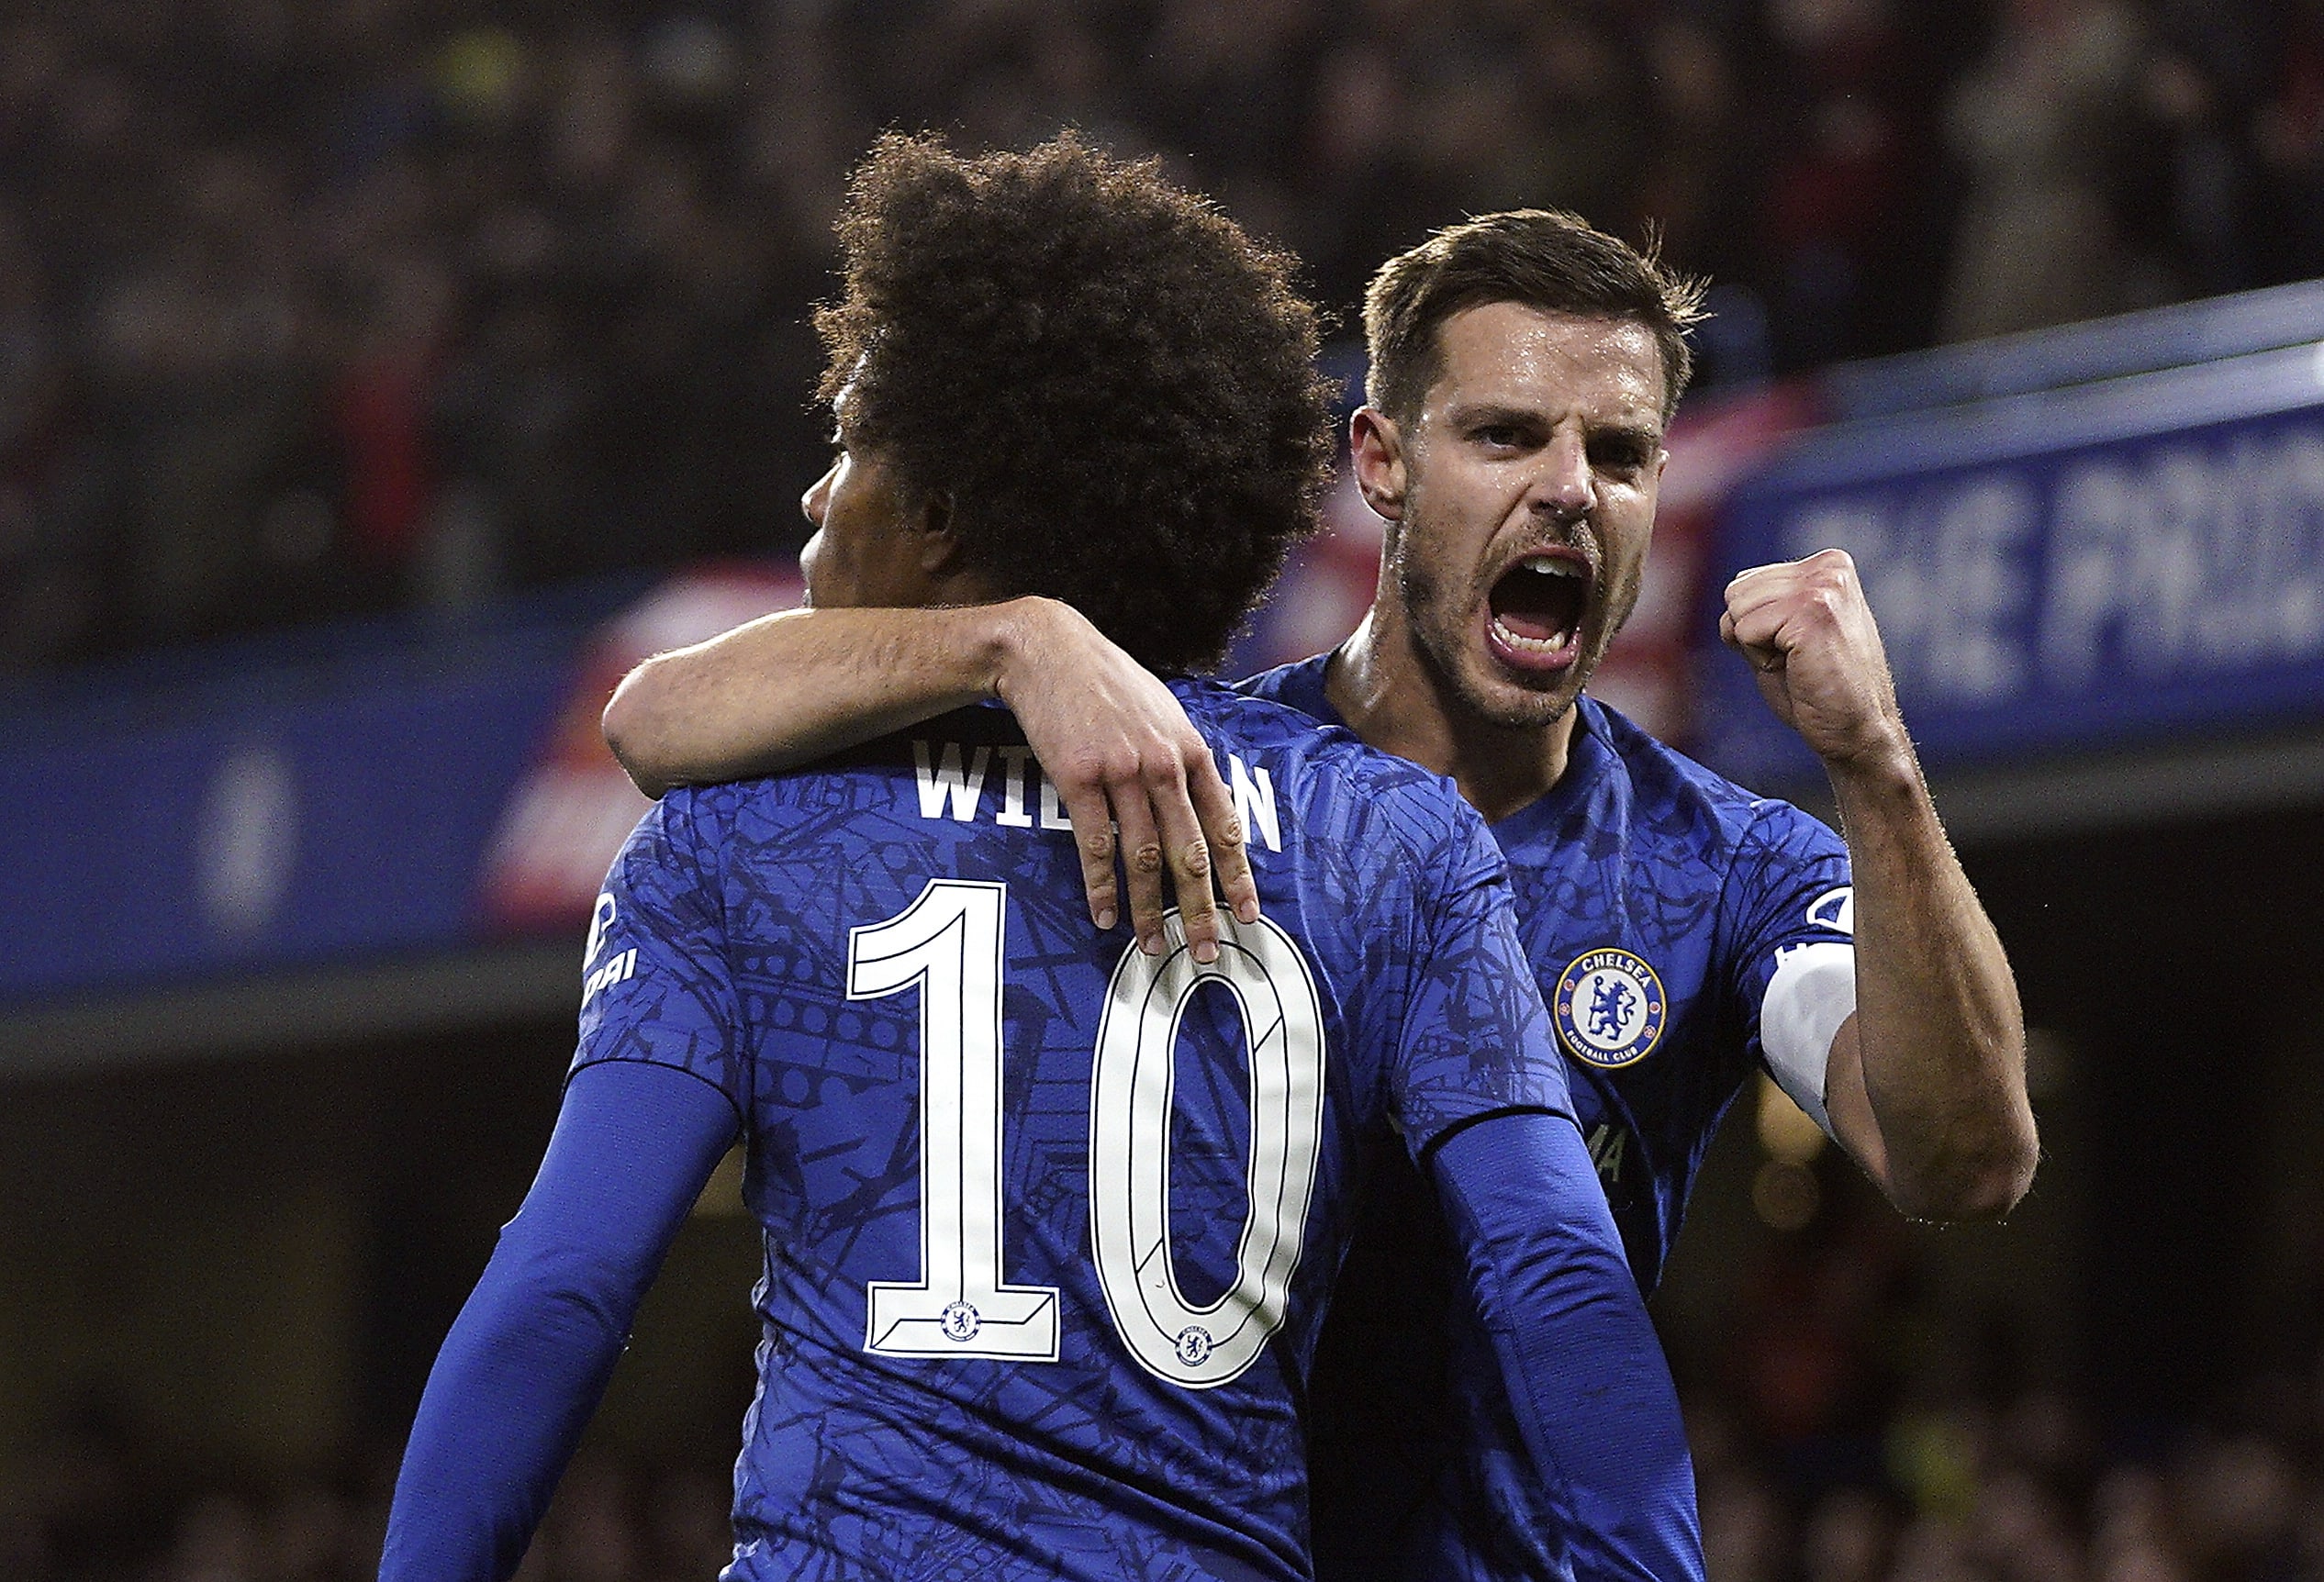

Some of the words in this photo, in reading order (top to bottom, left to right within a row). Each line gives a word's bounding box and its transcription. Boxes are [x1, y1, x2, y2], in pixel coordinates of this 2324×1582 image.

[912, 740, 1282, 853] WILN
[1581, 953, 1653, 988] CHELSEA
[1612, 1045, 1639, 1062] CLUB
[845, 878, 1327, 1390] 10
